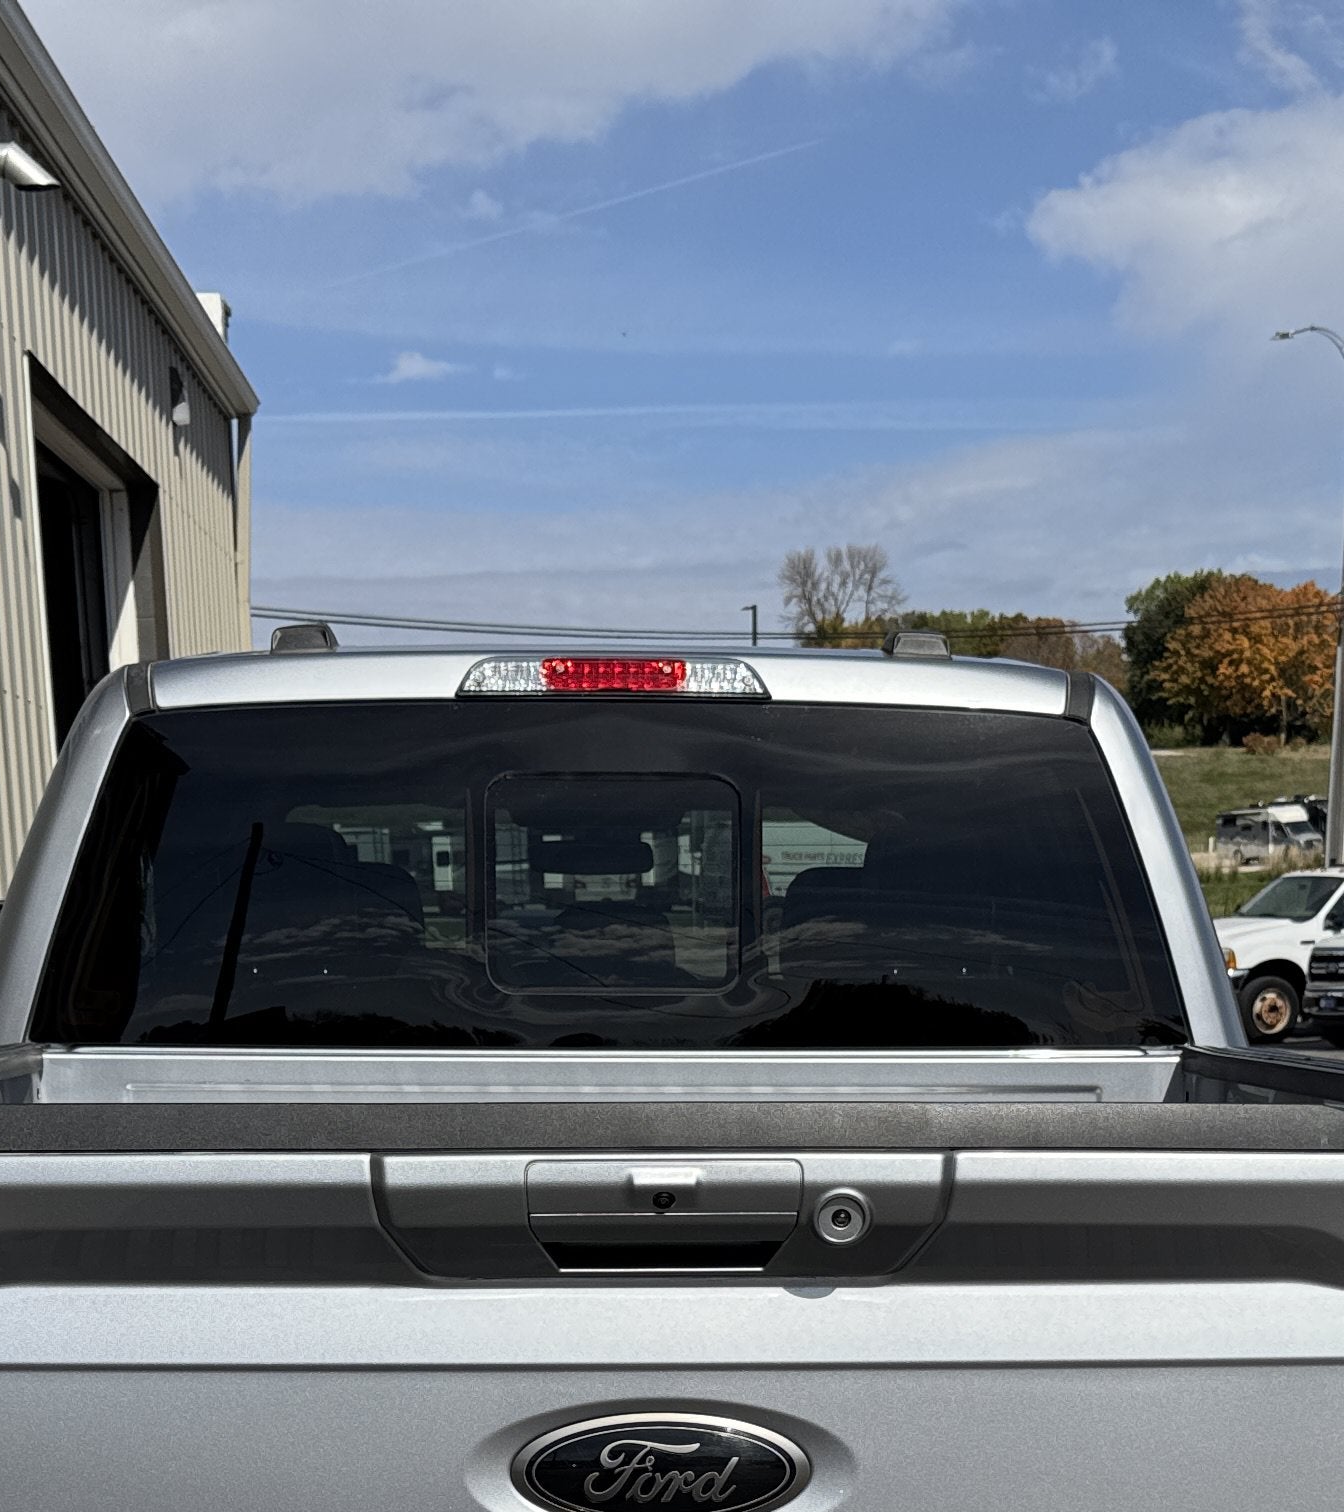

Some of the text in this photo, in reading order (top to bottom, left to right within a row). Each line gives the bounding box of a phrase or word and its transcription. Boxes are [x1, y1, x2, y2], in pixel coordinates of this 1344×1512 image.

[781, 851, 803, 861] TRUCK
[825, 852, 863, 865] EXPRES
[583, 1439, 740, 1503] Ford
